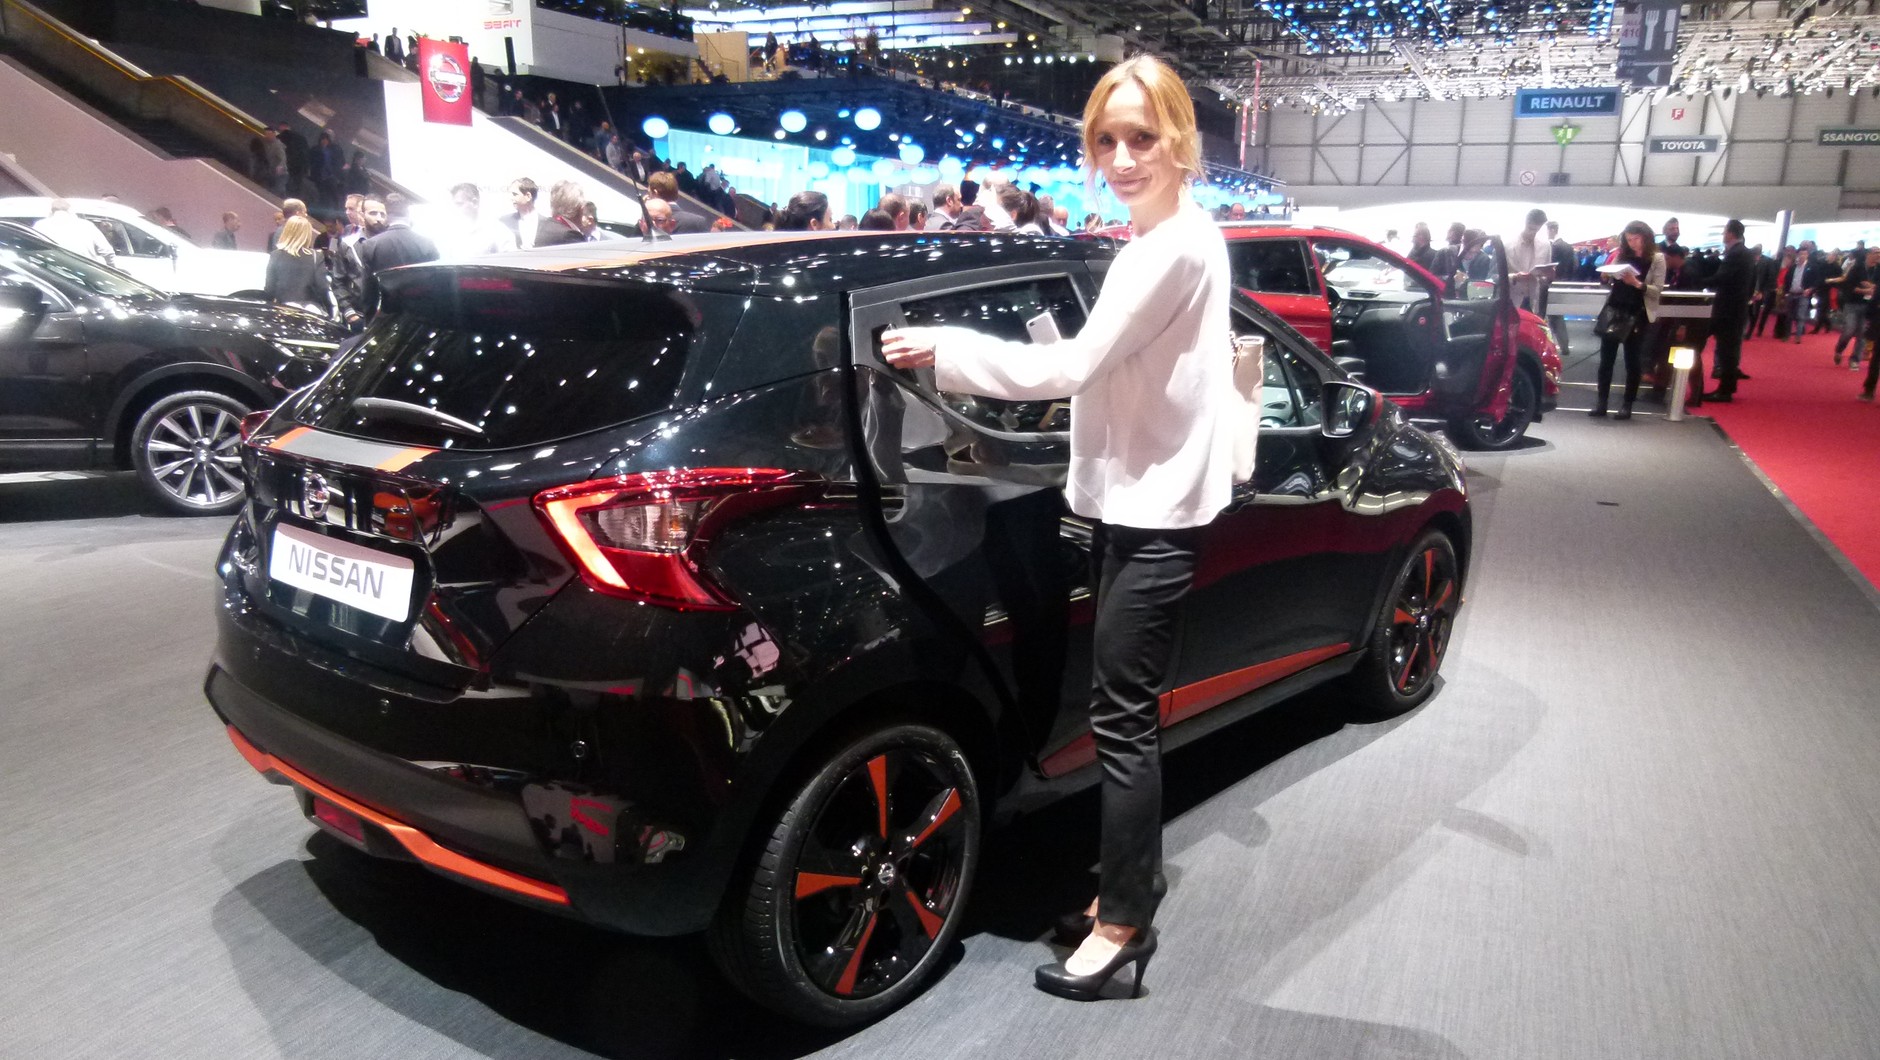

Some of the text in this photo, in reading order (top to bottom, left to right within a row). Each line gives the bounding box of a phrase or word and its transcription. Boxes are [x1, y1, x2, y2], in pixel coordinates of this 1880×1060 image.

[483, 19, 522, 30] SEAT
[1530, 95, 1606, 109] RENAULT
[1822, 133, 1880, 142] SSANGYO
[1661, 140, 1706, 150] TOYOTA
[288, 544, 384, 599] NISSAN
